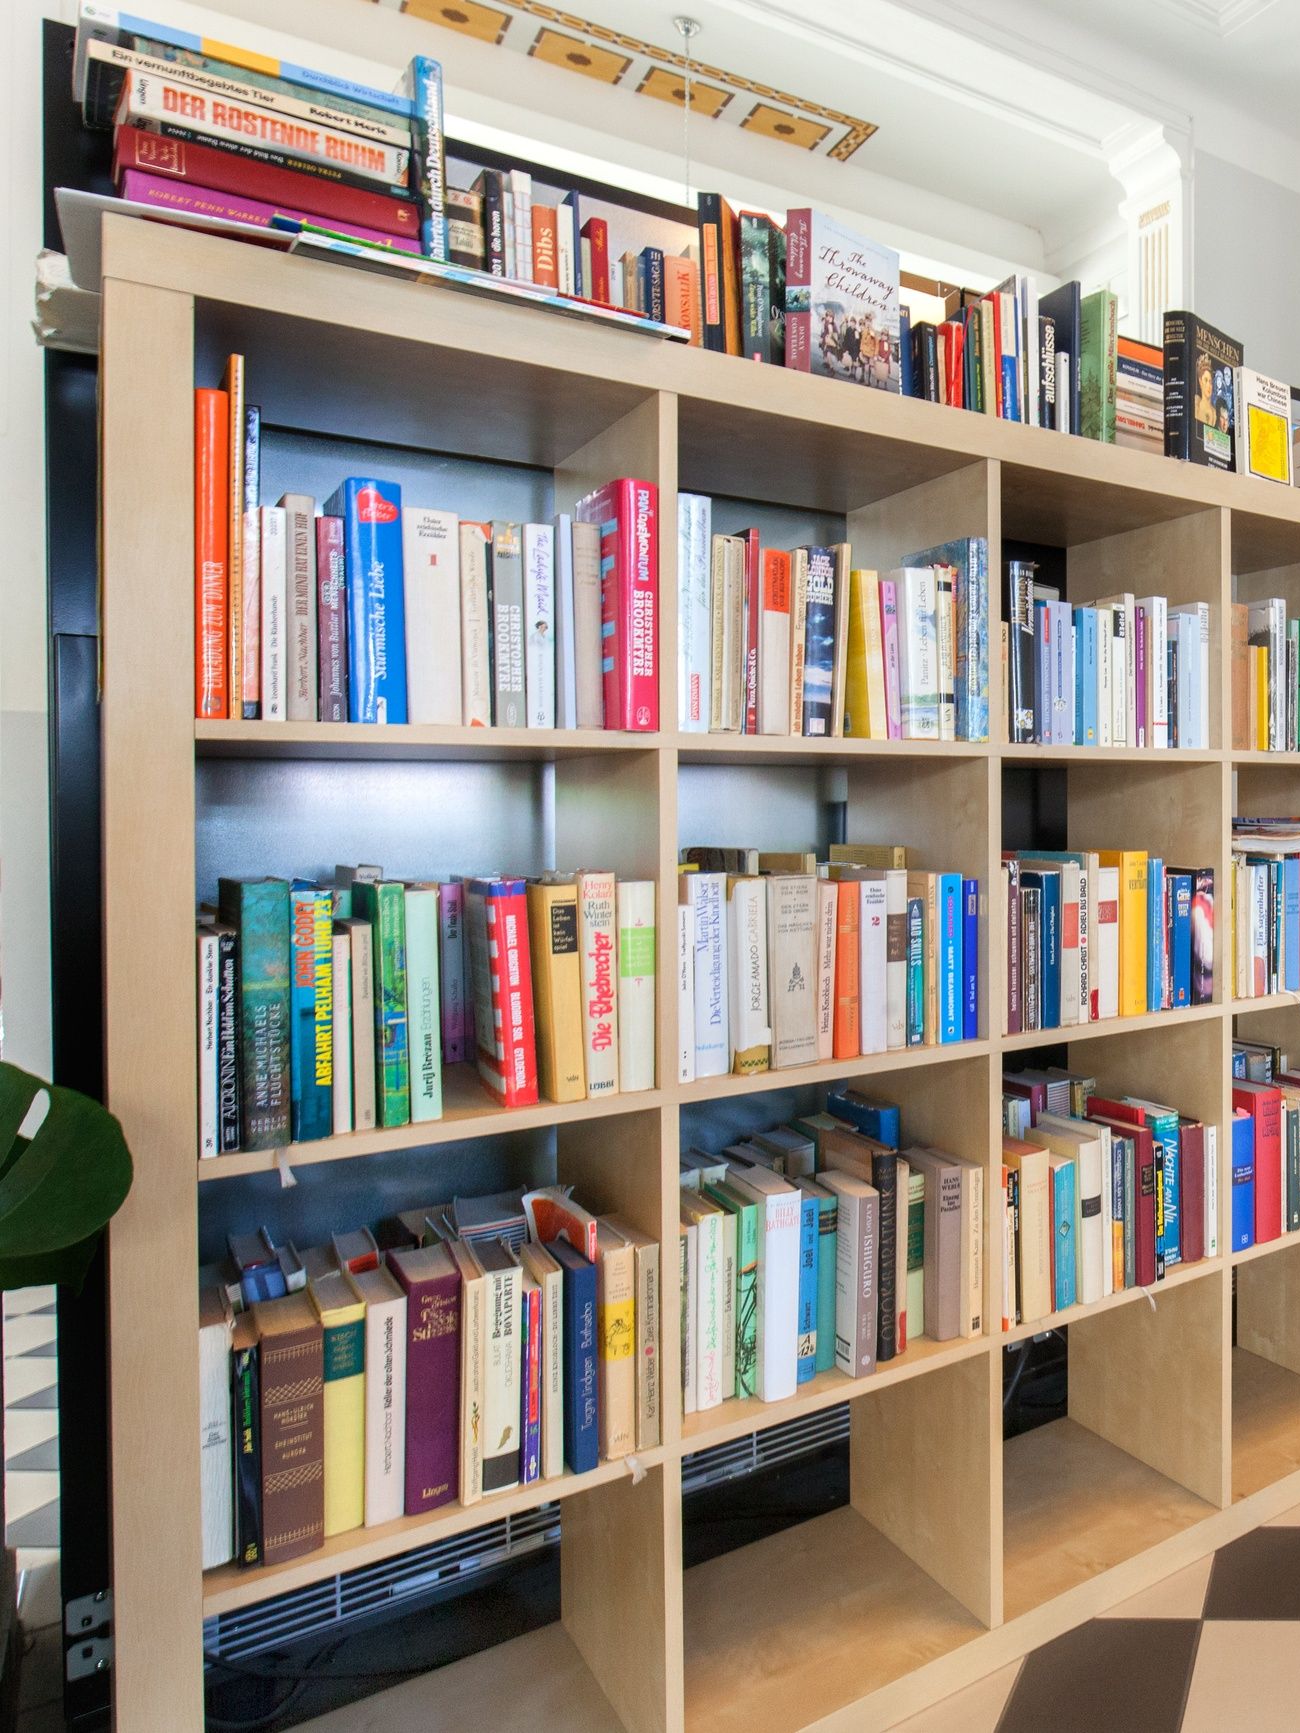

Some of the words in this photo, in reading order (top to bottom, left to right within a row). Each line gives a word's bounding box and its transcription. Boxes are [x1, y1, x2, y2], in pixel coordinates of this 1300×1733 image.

[111, 49, 132, 64] Ein
[251, 86, 276, 104] Tier
[162, 86, 206, 122] DER
[212, 97, 320, 155] ROSTENDE
[325, 137, 386, 173] RUHM
[310, 106, 352, 126] Robert
[424, 80, 442, 167] Deutschland
[426, 169, 443, 210] durch
[536, 227, 554, 271] Dibs
[850, 252, 867, 268] The
[819, 245, 896, 298] Throwaway
[827, 272, 888, 312] Children
[1042, 325, 1055, 403] aufschlüsse
[203, 561, 223, 600] DINNER
[369, 561, 385, 599] Liebe
[915, 581, 927, 608] Leben
[203, 603, 223, 627] ZUM
[331, 643, 341, 657] von
[369, 603, 387, 680] Stürmische
[498, 604, 510, 692] BROOKMYRE
[511, 605, 522, 692] CHRISTOPHER
[633, 590, 644, 676] BROOKMYRE
[644, 590, 653, 676] CHRISTOPHER
[918, 625, 928, 651] Leben
[203, 630, 223, 688] EINLADUNG
[918, 658, 929, 685] Panitz
[315, 901, 333, 918] 23
[584, 910, 612, 920] Winter
[588, 901, 610, 910] Ruth
[697, 882, 709, 917] Walser
[708, 882, 720, 926] Kindheit
[295, 901, 314, 947] GODEY
[316, 921, 333, 948] UHR
[697, 917, 709, 952] Martin
[709, 927, 721, 944] der
[911, 918, 922, 935] MAD
[295, 951, 315, 987] JOHN
[750, 946, 760, 980] AMADO
[910, 938, 922, 966] SKILLS
[316, 962, 333, 1021] PELHAM
[589, 932, 613, 1018] Ehebrecher
[750, 983, 762, 1011] JORGE
[822, 976, 831, 1011] Knobloch
[255, 1005, 268, 1070] MICHAELS
[592, 1023, 612, 1051] Die
[821, 1013, 830, 1034] Heinz
[222, 1041, 236, 1058] Ein
[268, 1003, 283, 1106] FLUCHTSTÜCKE
[316, 1024, 333, 1086] ABFAHRT
[256, 1074, 268, 1107] ANNE
[804, 1208, 814, 1228] Jael
[1164, 1204, 1177, 1227] NIL
[803, 1248, 813, 1268] Joel
[863, 1234, 873, 1298] ISHIGURO
[503, 1274, 512, 1336] BONAPARTE
